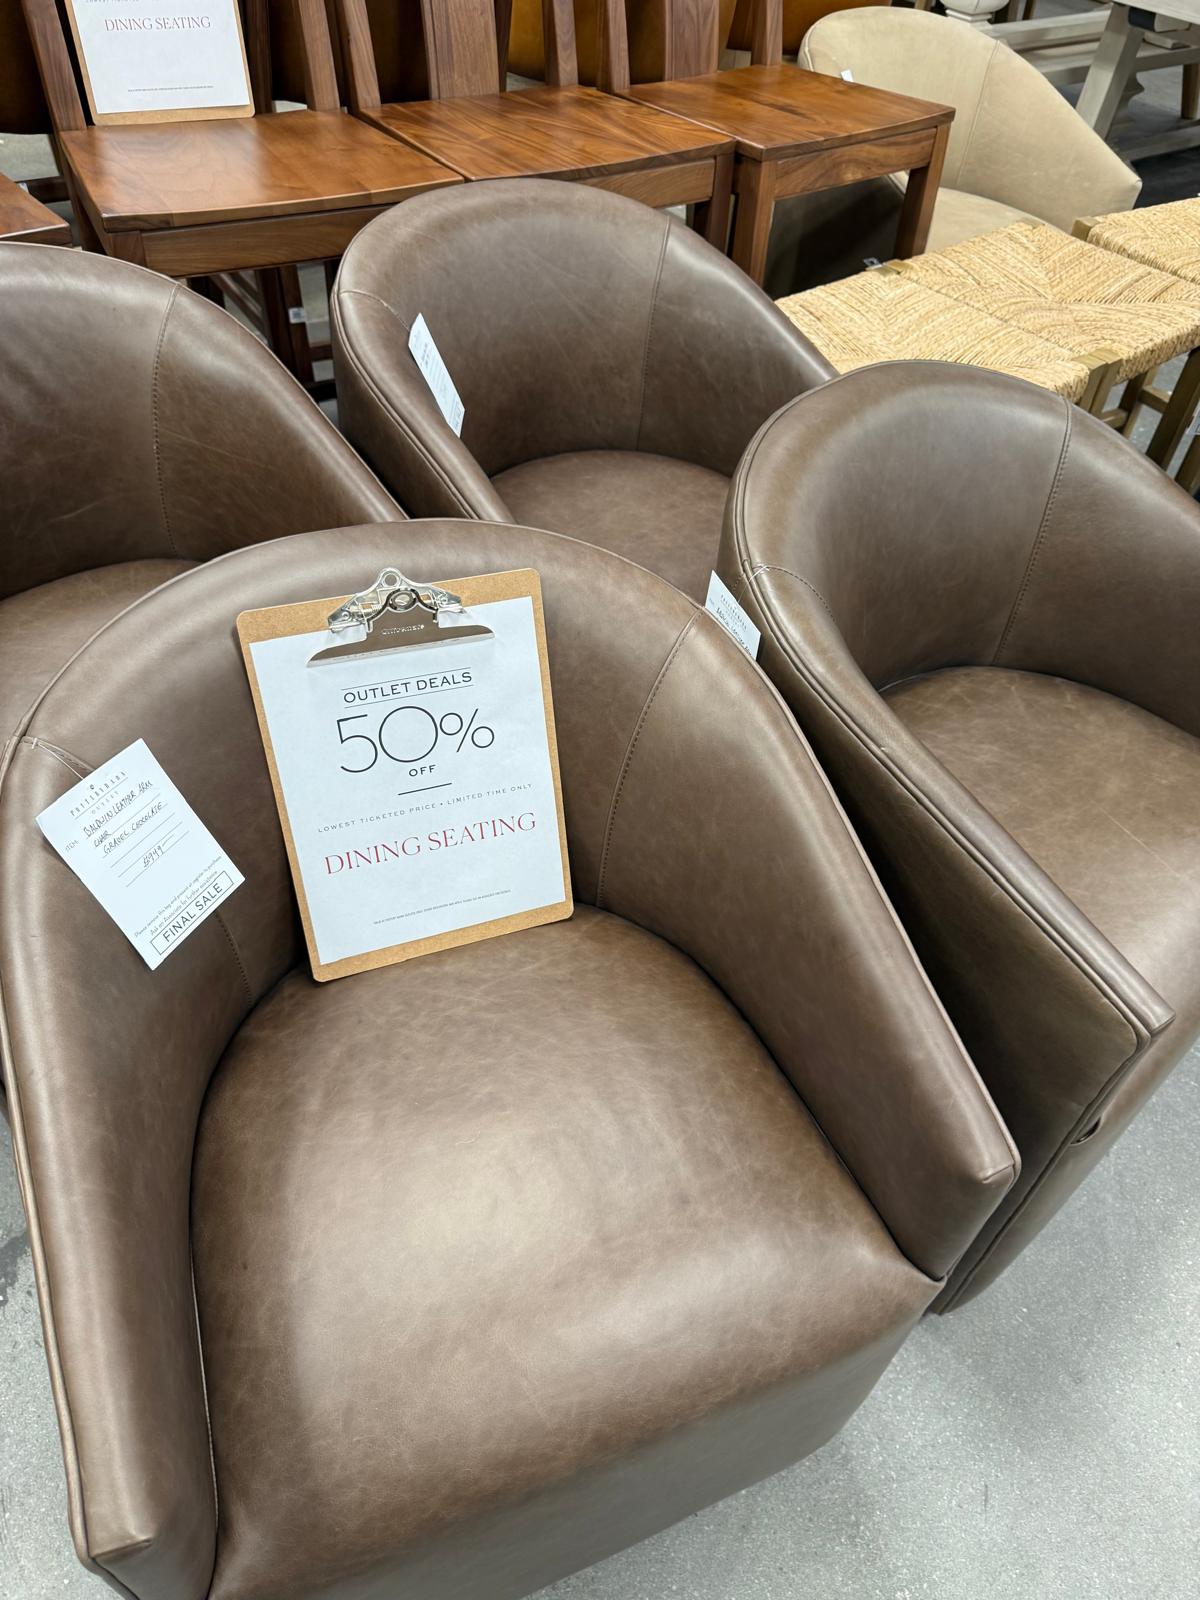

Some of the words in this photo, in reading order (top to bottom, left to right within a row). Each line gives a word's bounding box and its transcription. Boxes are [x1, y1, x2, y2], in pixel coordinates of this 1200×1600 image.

[105, 18, 152, 31] DINING
[155, 16, 211, 30] SEATING
[344, 682, 411, 704] OUTLET
[416, 671, 473, 692] DEALS
[336, 705, 495, 773] 50%
[408, 764, 436, 777] OFF
[318, 819, 356, 832] LOWEST
[360, 809, 406, 824] TICKETED
[409, 803, 437, 814] PRICE
[447, 790, 483, 805] LIMITED
[487, 787, 507, 797] TIME
[510, 783, 533, 792] ONLY
[324, 836, 422, 875] DINING
[427, 812, 537, 852] SEATING
[163, 911, 196, 942] FINAL
[195, 883, 222, 910] SALE
